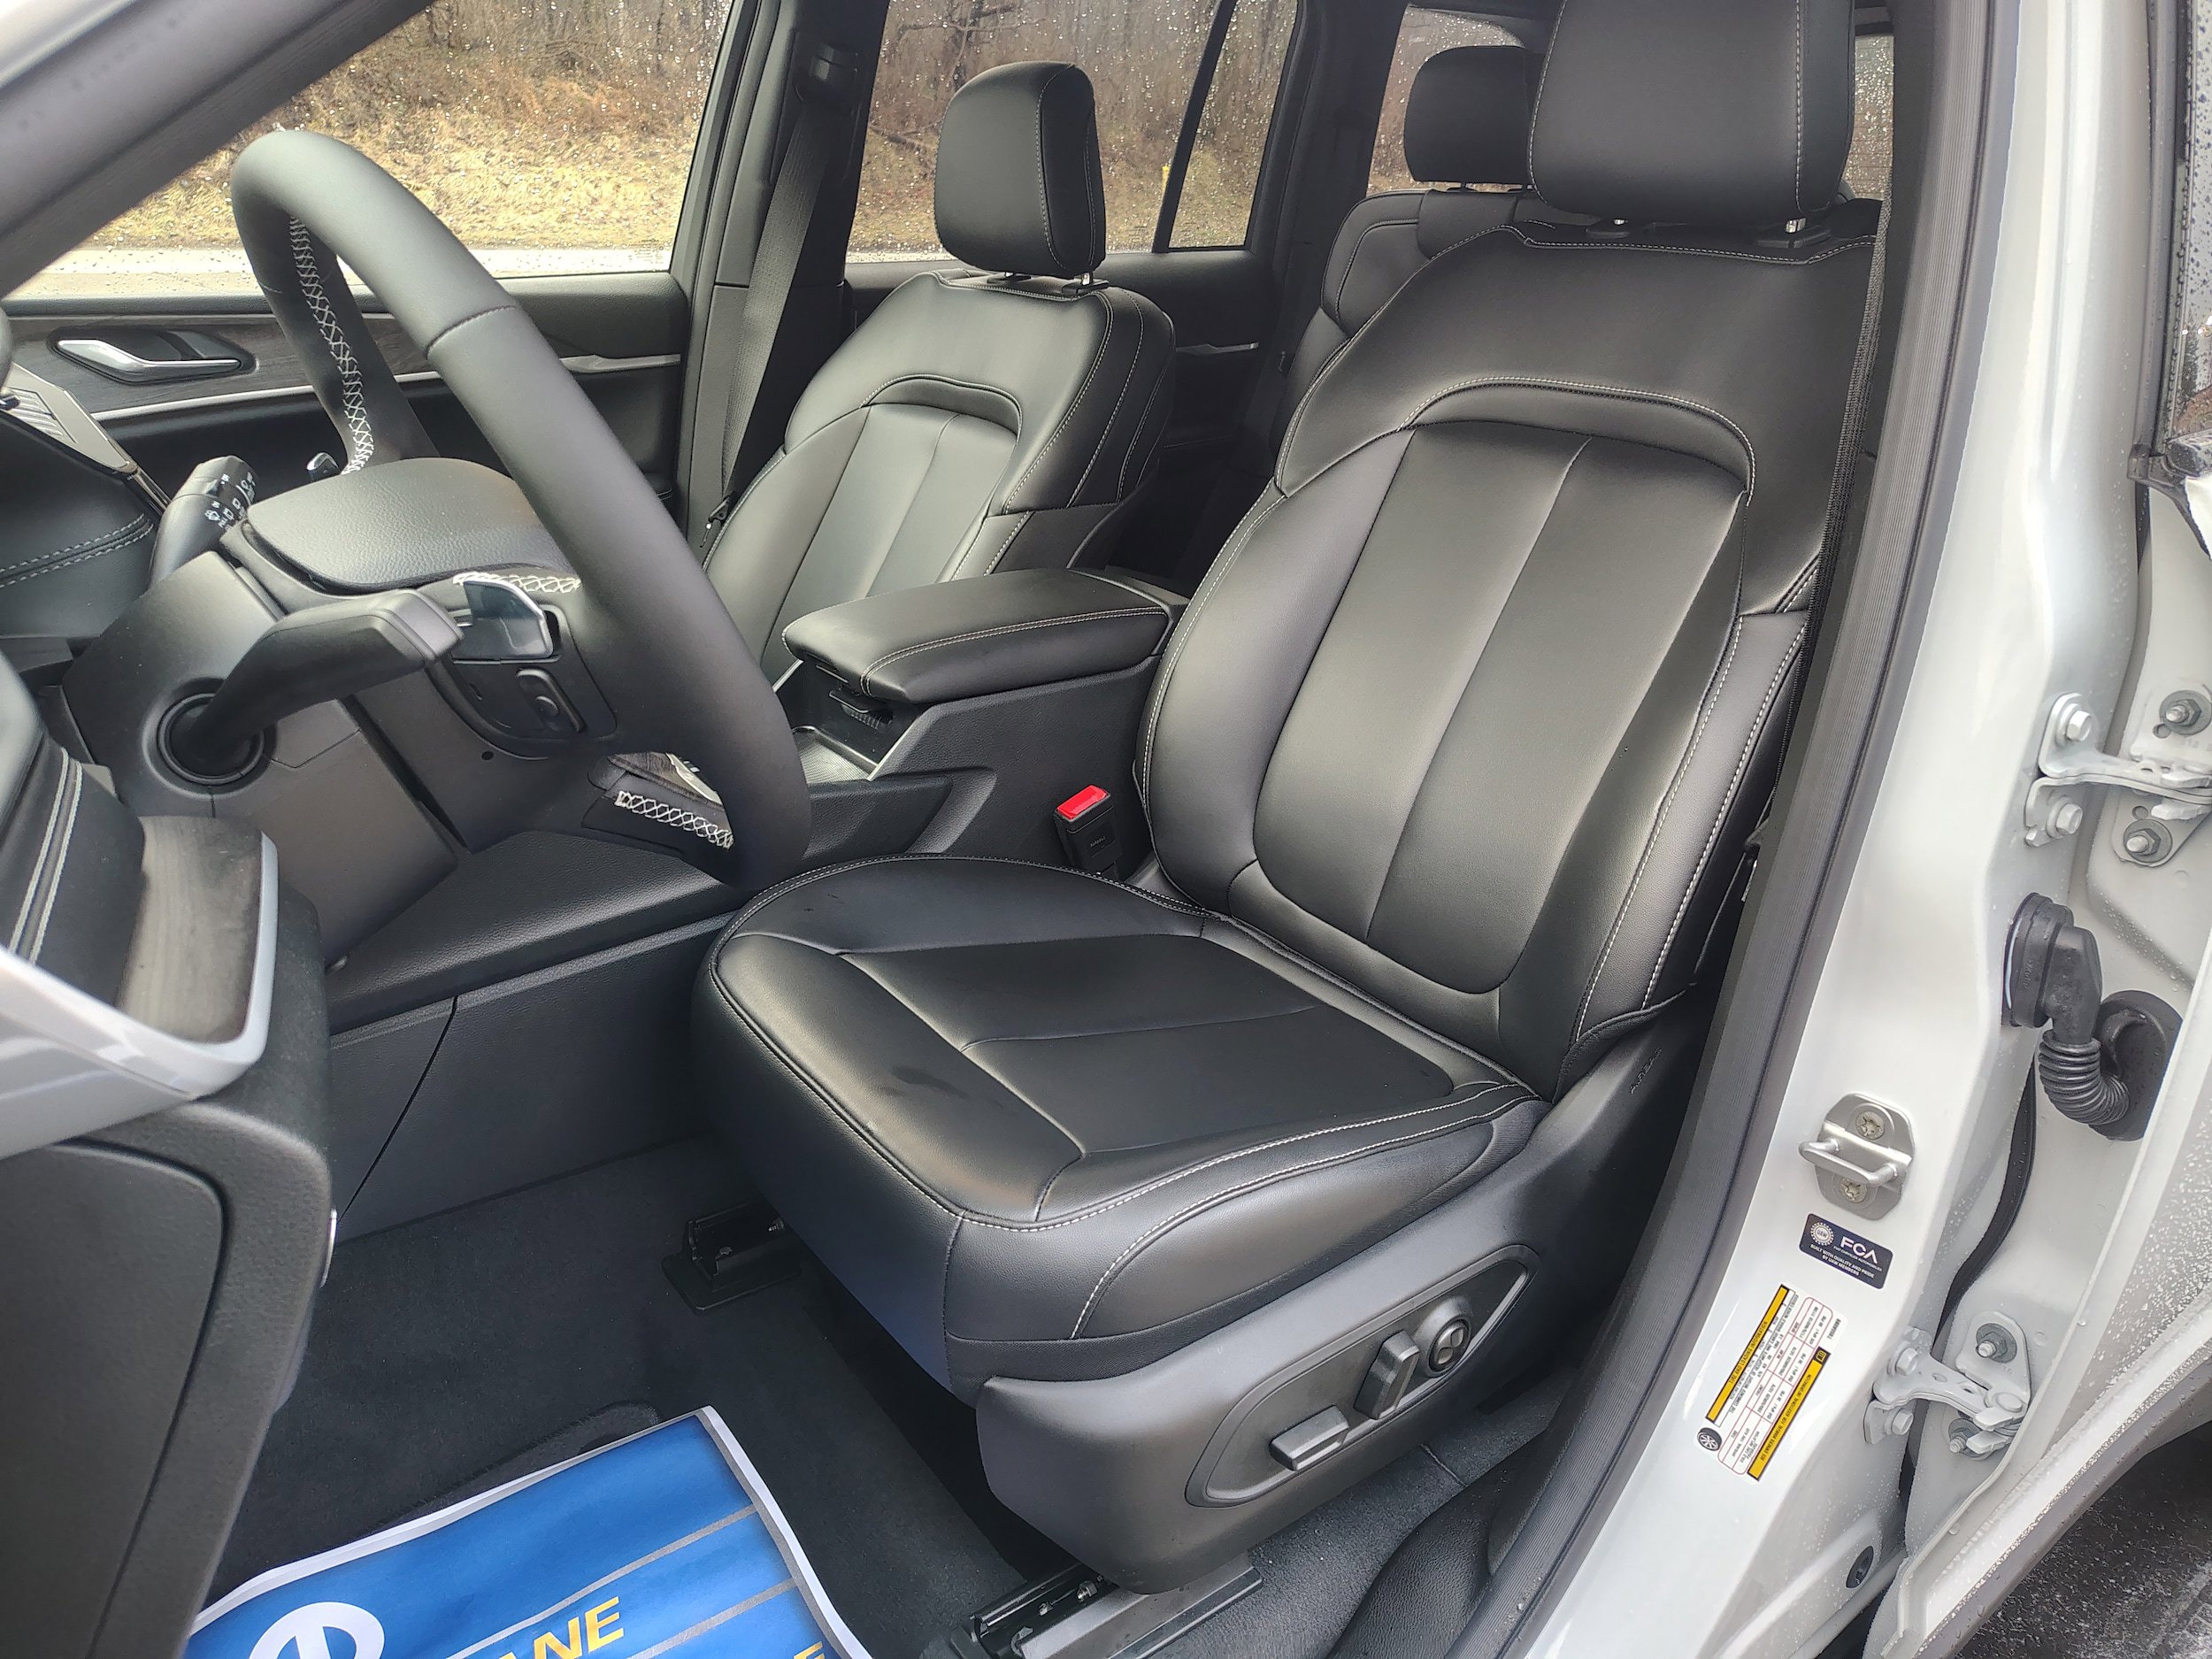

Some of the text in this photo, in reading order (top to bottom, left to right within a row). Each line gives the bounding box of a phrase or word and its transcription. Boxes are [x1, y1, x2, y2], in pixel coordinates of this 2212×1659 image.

[1823, 1249, 1833, 1258] WITH
[1833, 1256, 1851, 1266] QUALITY
[1862, 1269, 1874, 1278] PRIDE
[1840, 1236, 1878, 1263] FCA
[1840, 1249, 1858, 1260] CHRYSLER
[1858, 1258, 1882, 1271] AUTOMOBILES
[1838, 1263, 1859, 1275] MEMBERS
[1728, 1374, 1737, 1384] TIRE
[1740, 1348, 1752, 1365] LOADING
[1750, 1321, 1768, 1348] INFORMATION
[1772, 1425, 1783, 1440] MANUAL
[1786, 1397, 1799, 1417] ADDITIONAL
[1796, 1374, 1811, 1397] INFORMATION
[500, 1596, 624, 1659] NE
